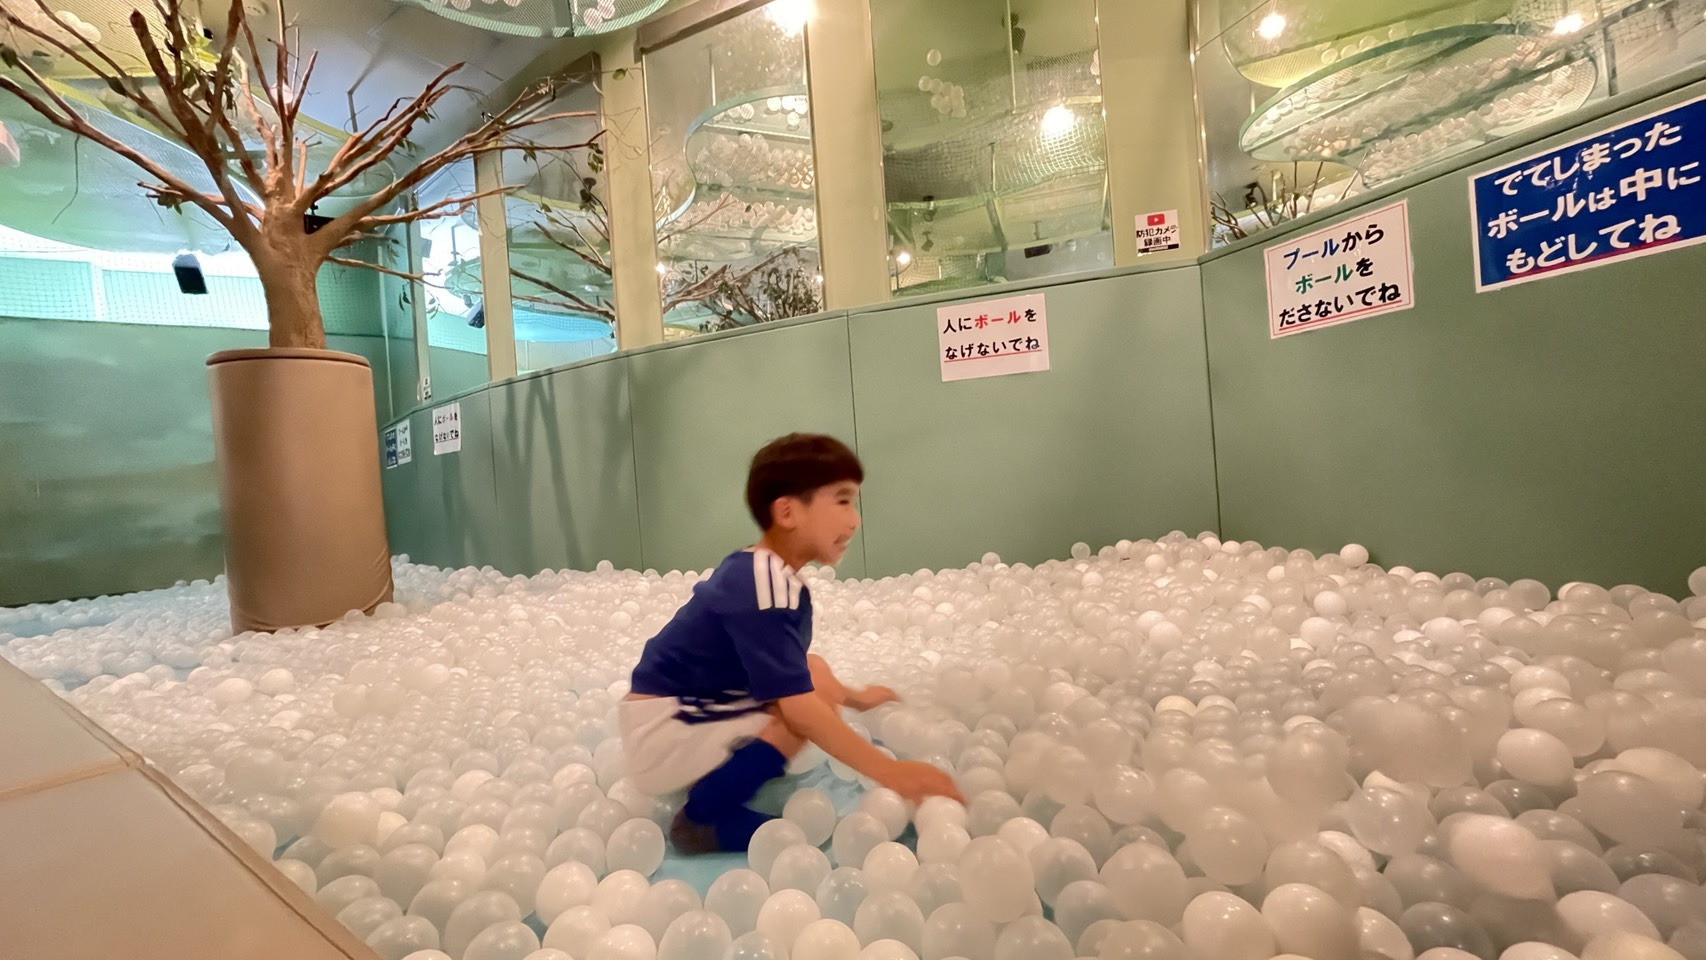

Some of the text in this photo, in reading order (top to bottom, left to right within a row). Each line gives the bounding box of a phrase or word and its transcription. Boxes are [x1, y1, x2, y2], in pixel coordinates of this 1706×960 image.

[1494, 121, 1683, 196] でてしまった
[1488, 161, 1702, 239] ボールは中に
[1136, 225, 1178, 238] 防犯カメラ
[1283, 224, 1385, 270] プールから
[1505, 213, 1682, 275] もどしてね
[1295, 257, 1374, 295] ボールを
[943, 309, 1037, 334] 人にボールを
[1279, 283, 1402, 328] ださないでね
[945, 336, 1040, 360] なげないでね
